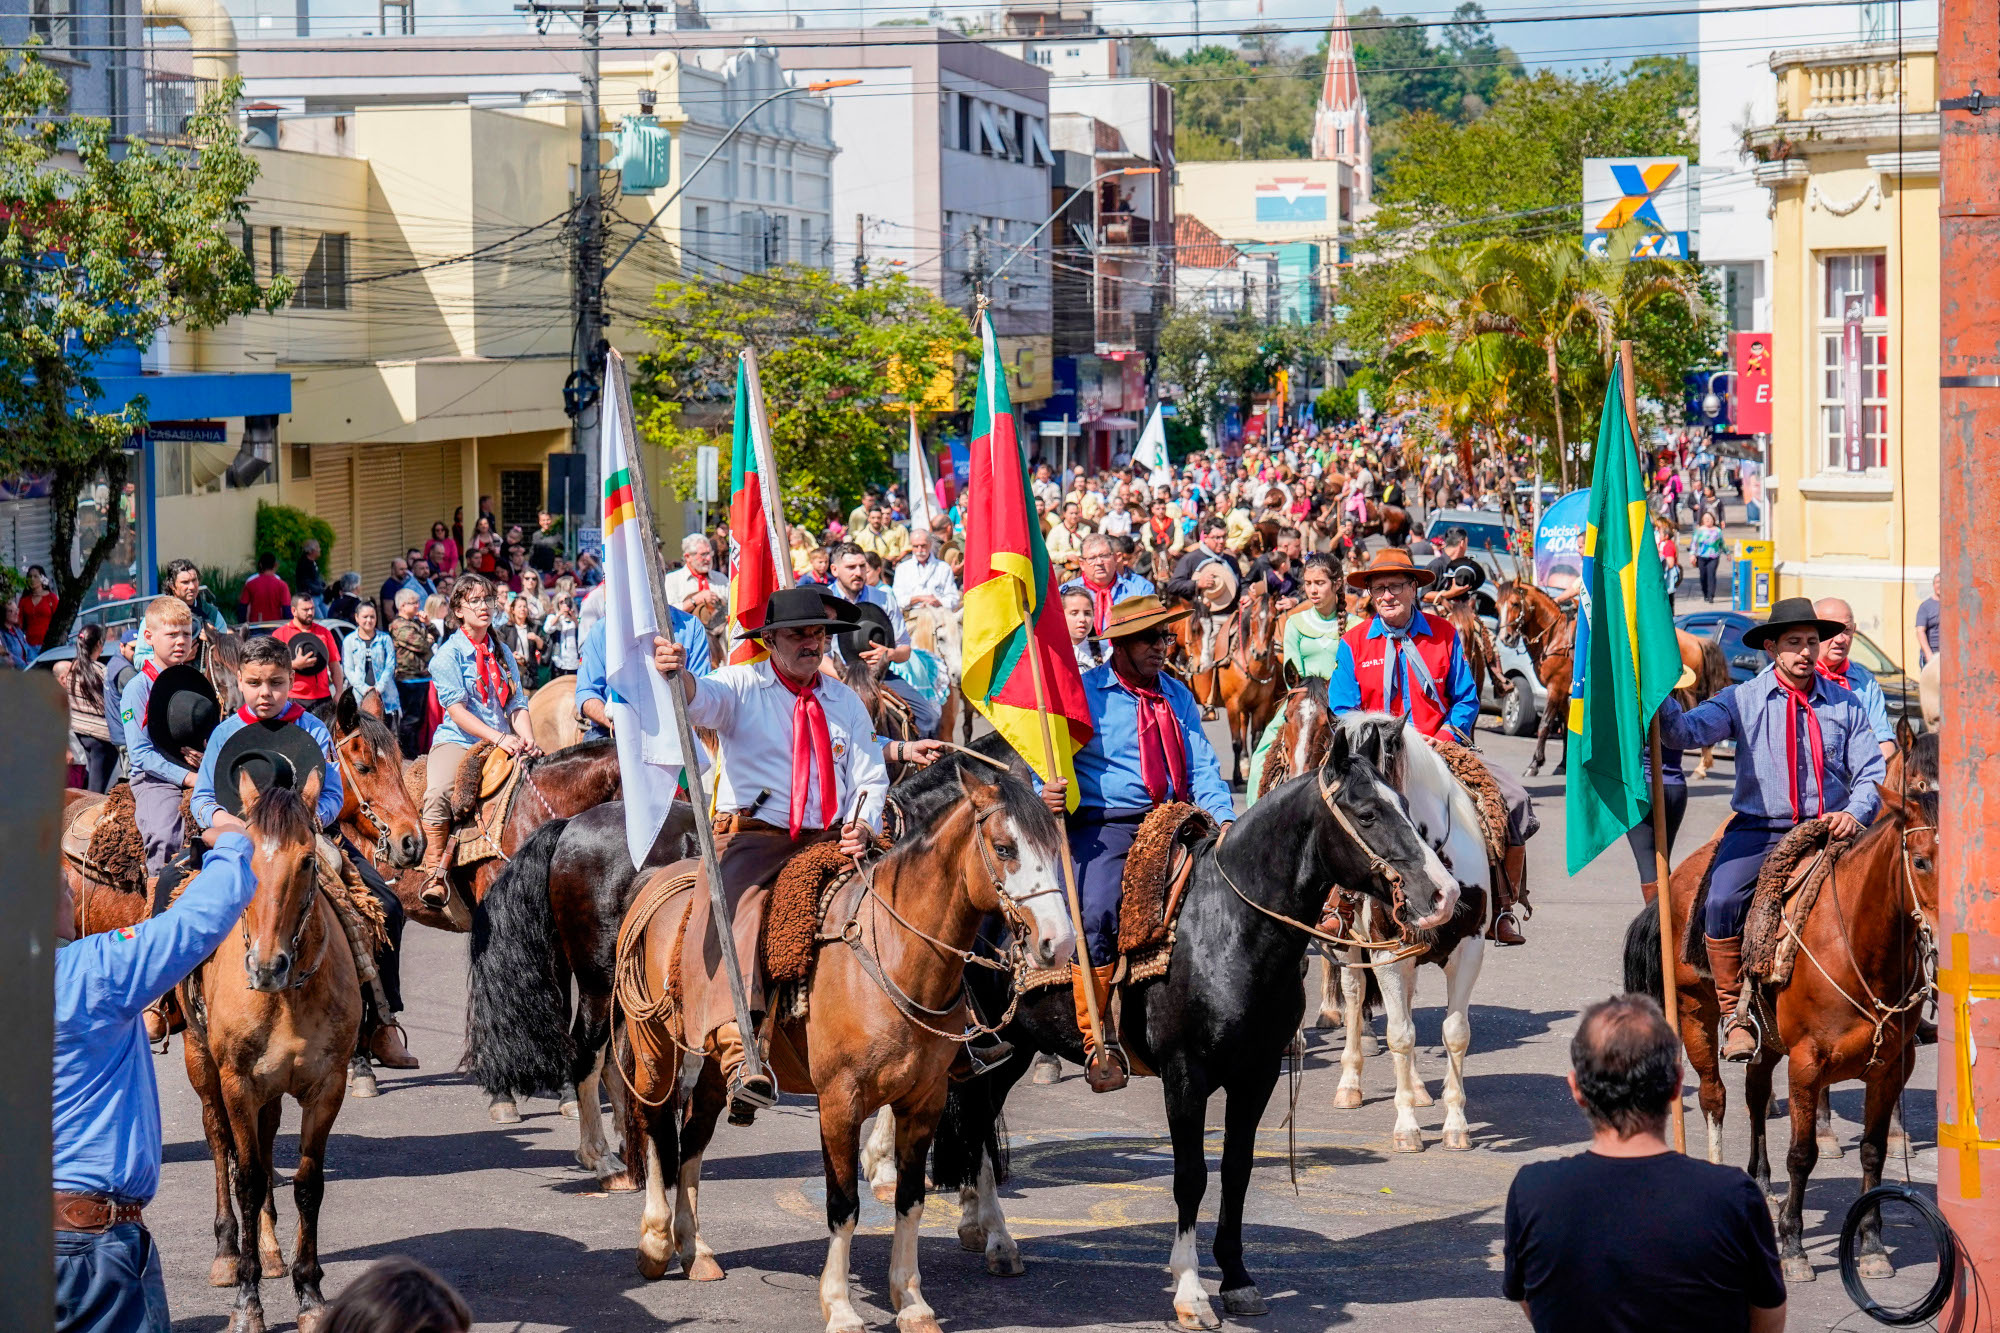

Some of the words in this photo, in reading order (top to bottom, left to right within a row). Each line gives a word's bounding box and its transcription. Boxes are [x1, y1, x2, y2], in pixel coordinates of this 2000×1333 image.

[1589, 235, 1681, 257] CXA
[1755, 384, 1774, 403] E
[1545, 536, 1580, 553] 404
